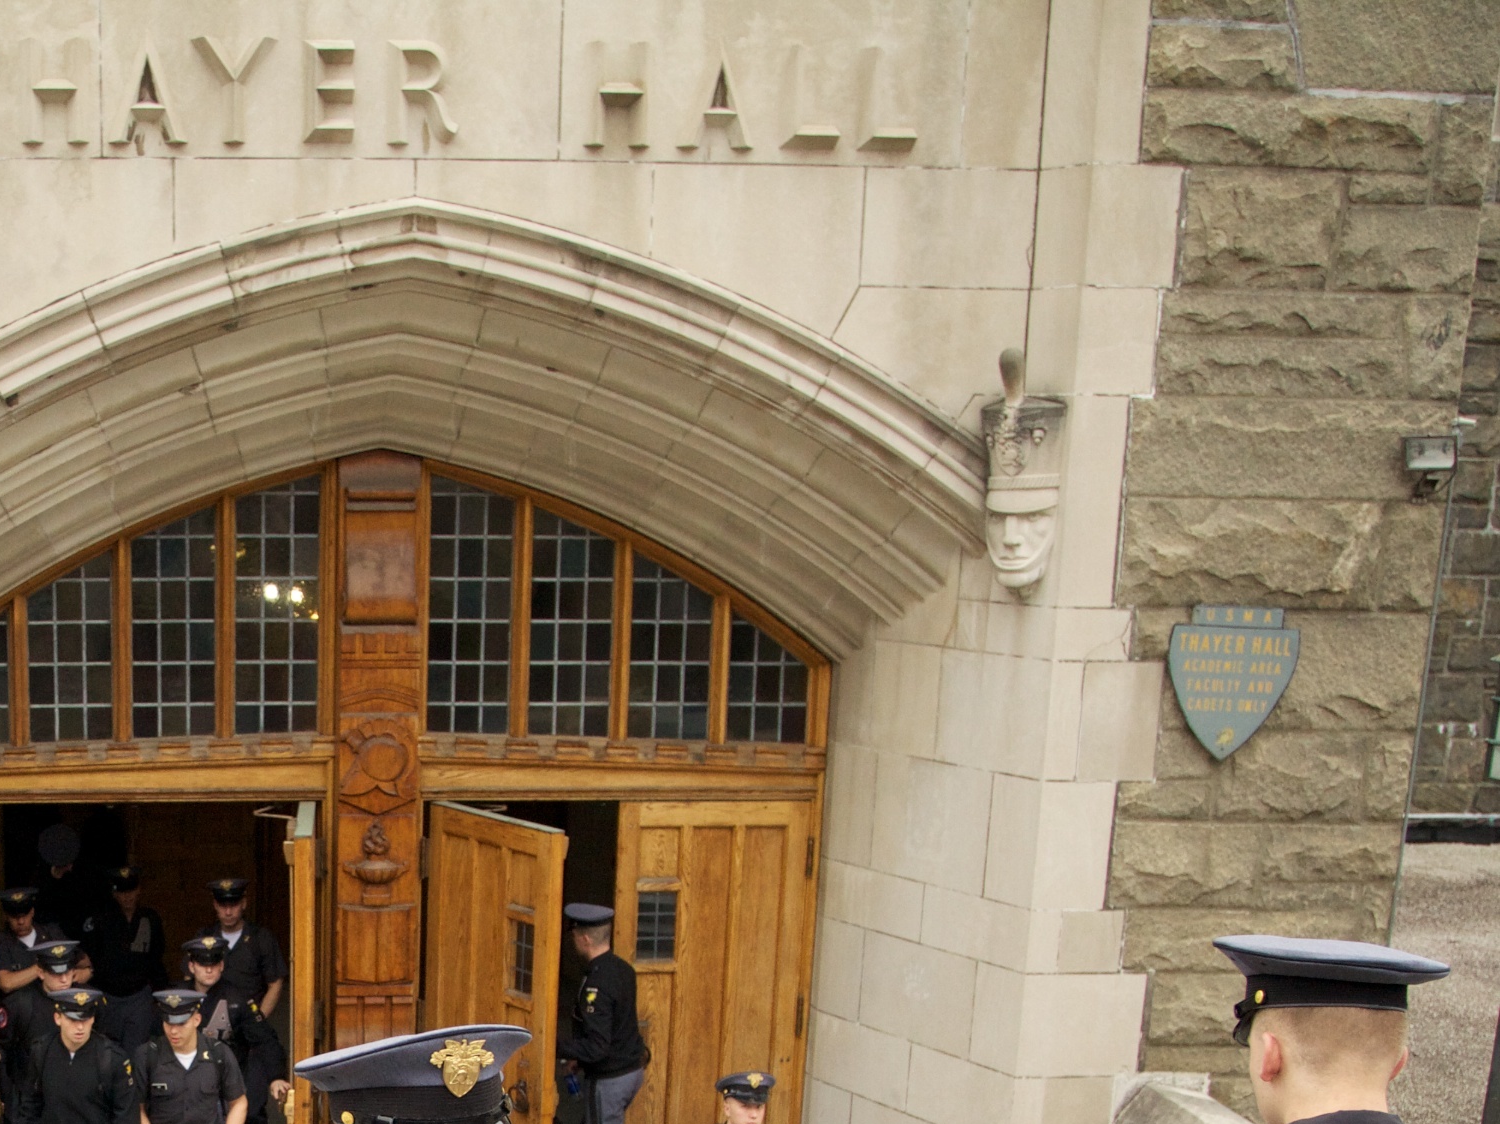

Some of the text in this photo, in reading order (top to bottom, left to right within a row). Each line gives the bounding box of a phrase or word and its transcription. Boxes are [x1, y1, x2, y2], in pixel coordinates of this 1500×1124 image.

[583, 38, 919, 152] HALL
[1180, 633, 1291, 657] THAYER HALL
[1183, 659, 1281, 675] ACADEMIC AREA
[1248, 681, 1273, 694] AND
[1187, 697, 1232, 712] CADETS
